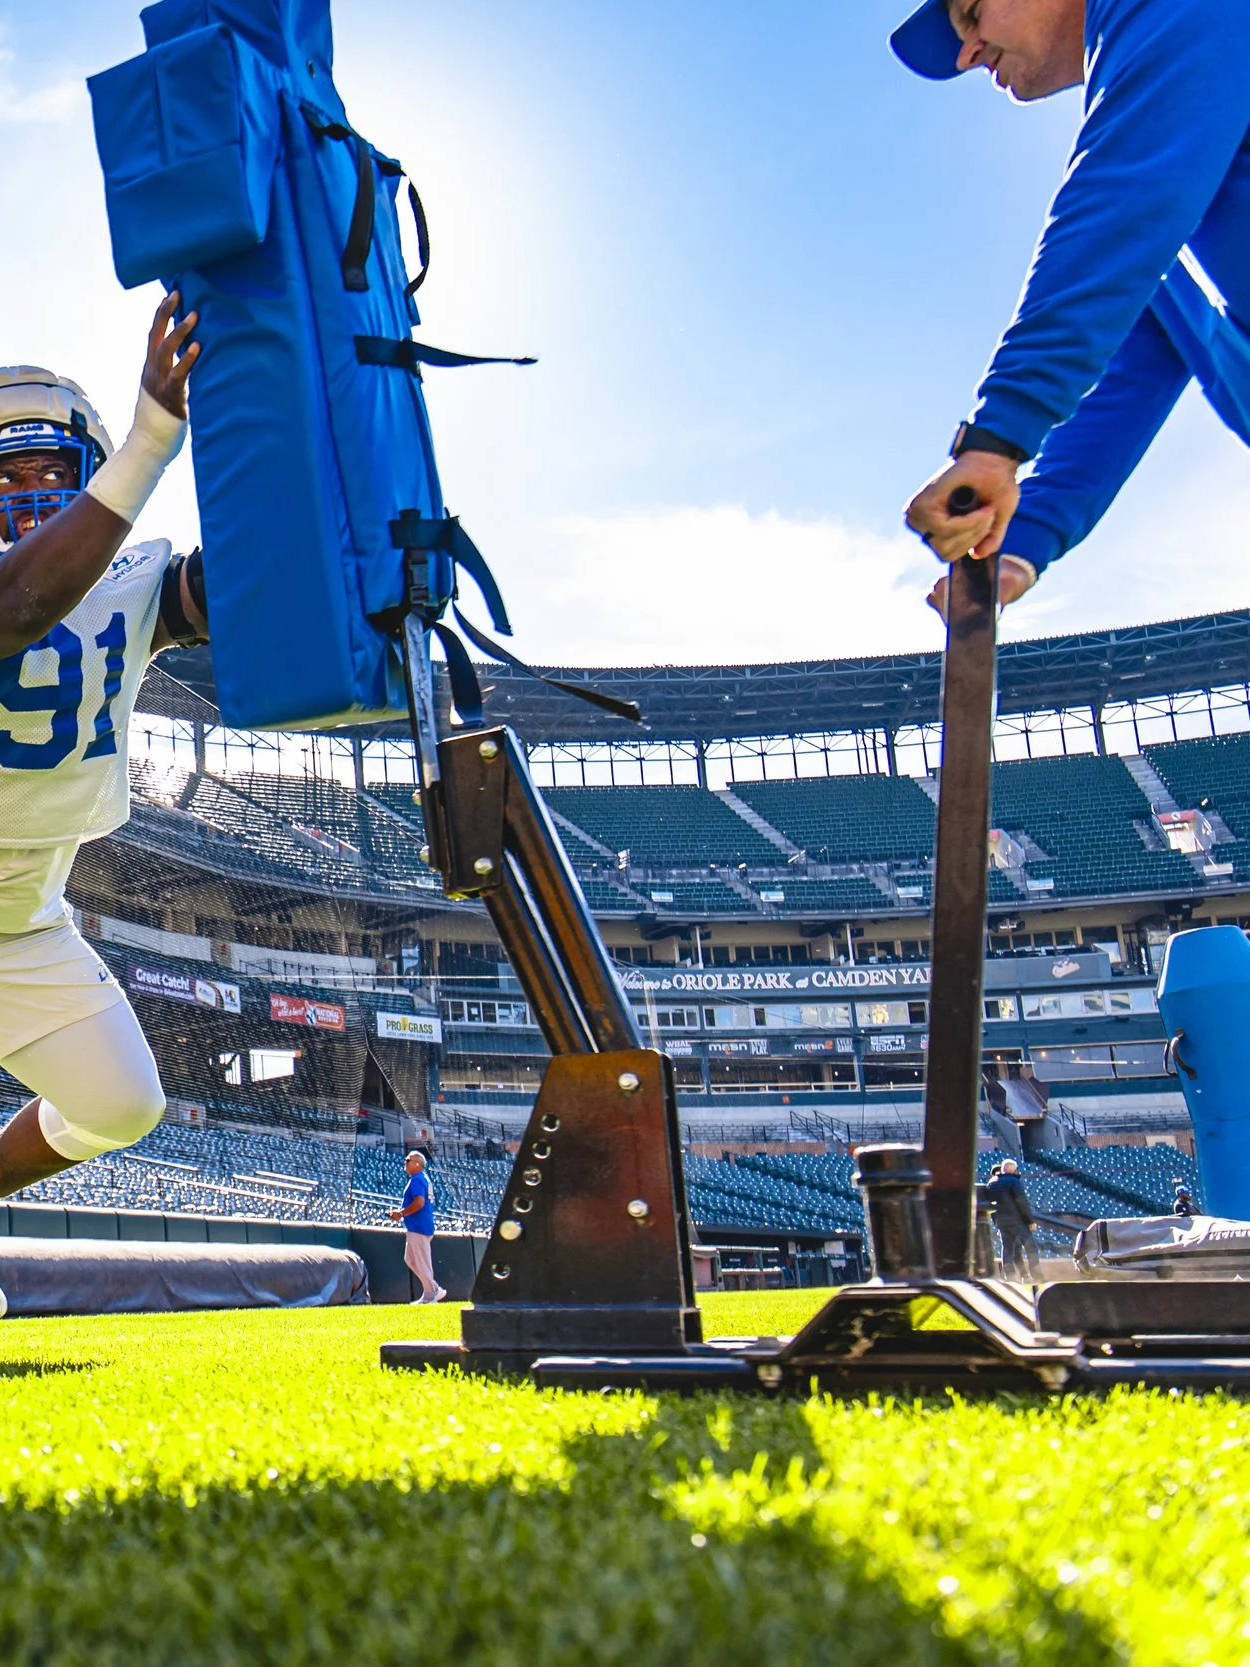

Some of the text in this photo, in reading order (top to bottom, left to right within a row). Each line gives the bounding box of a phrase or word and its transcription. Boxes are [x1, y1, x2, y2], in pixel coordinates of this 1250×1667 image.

[10, 425, 44, 434] RAMS
[135, 968, 161, 988] Great
[161, 973, 190, 991] Catch!
[672, 973, 741, 990] ORIOLE
[743, 973, 793, 989] PARK
[811, 968, 896, 988] CAMDEN
[386, 1020, 433, 1035] PRO GRASS
[665, 1040, 690, 1048] WBAL
[870, 1035, 904, 1045] ESPN
